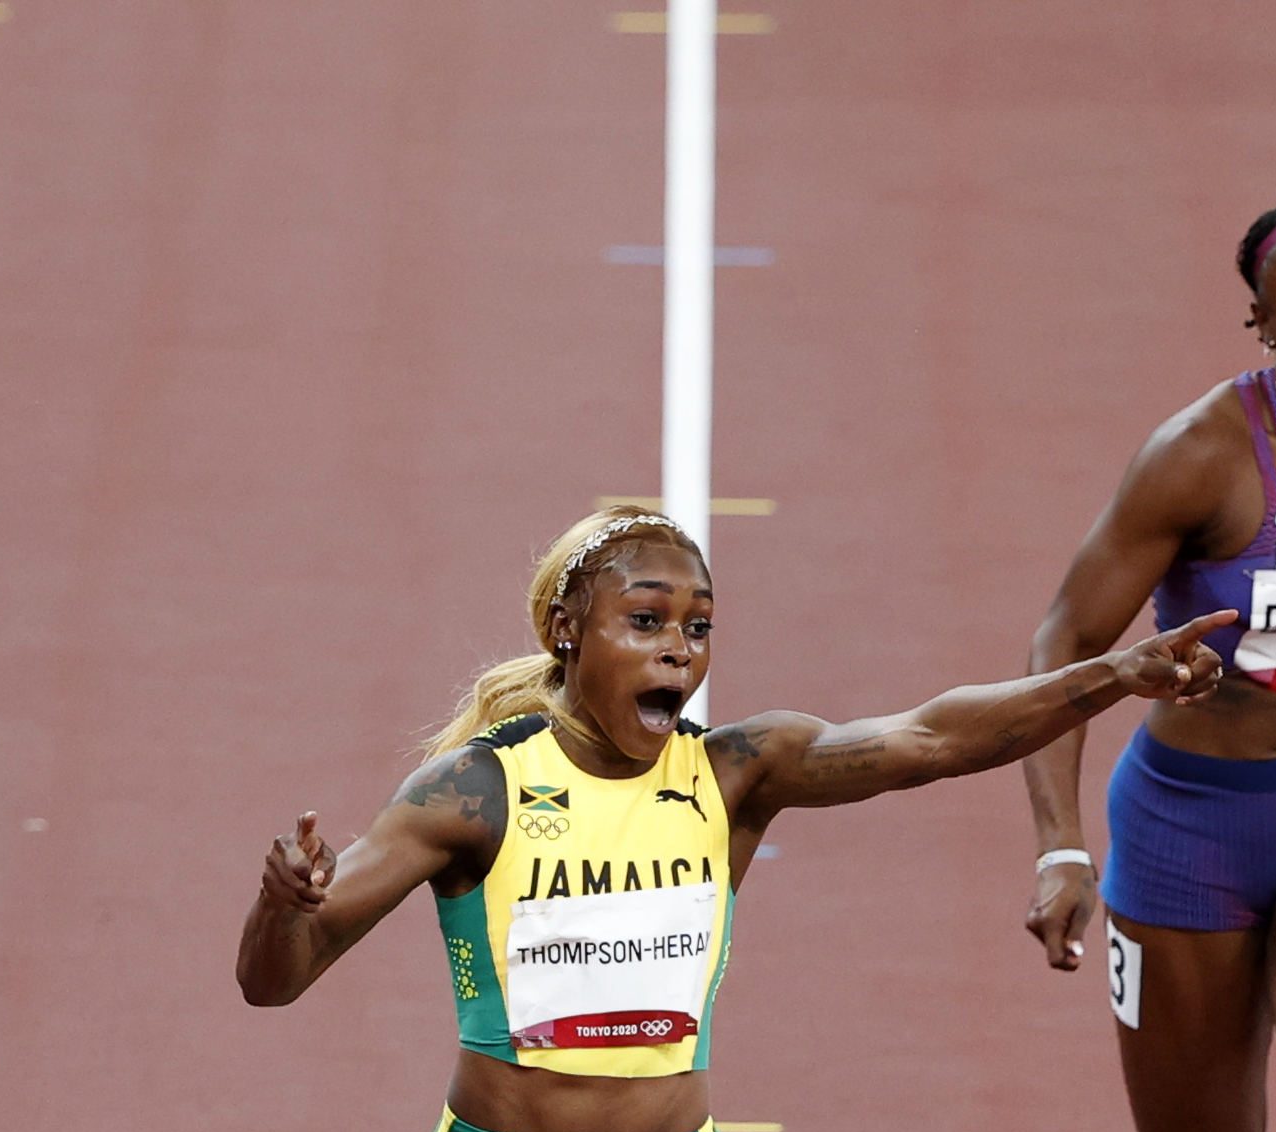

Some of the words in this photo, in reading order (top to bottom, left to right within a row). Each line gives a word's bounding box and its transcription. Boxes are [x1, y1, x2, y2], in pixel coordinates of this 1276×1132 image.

[517, 856, 713, 902] JAMAICA
[1111, 937, 1126, 1005] 3
[576, 1026, 611, 1037] TOKYO
[612, 1024, 638, 1036] 2020
